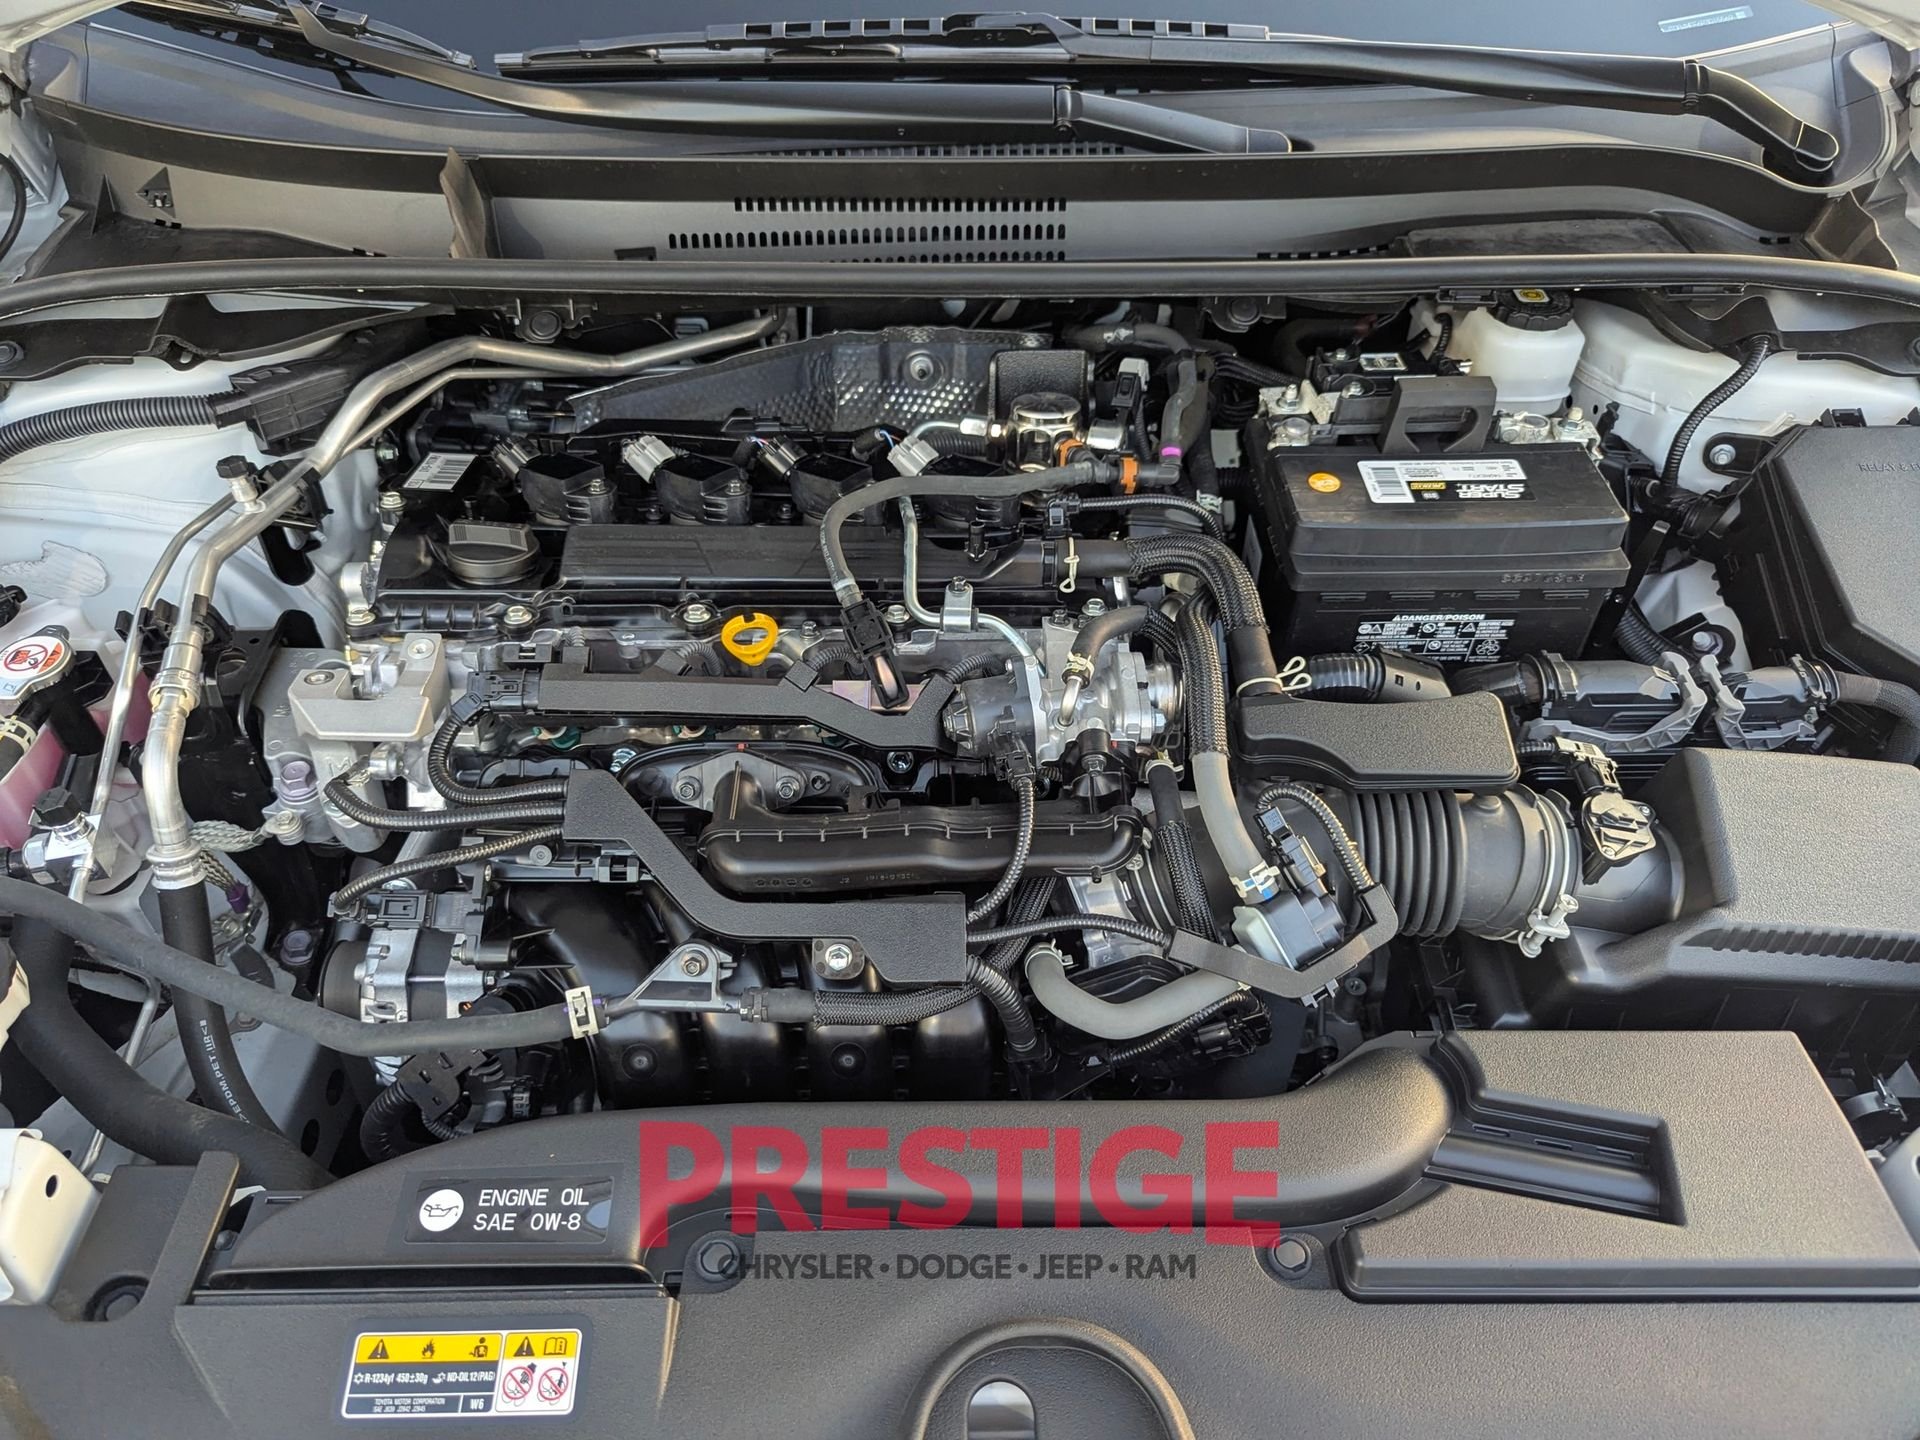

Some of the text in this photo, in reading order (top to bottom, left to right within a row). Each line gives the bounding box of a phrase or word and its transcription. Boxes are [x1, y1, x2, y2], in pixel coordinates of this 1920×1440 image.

[1857, 462, 1896, 472] RELAY
[1456, 483, 1525, 493] START
[1458, 491, 1521, 499] SUPER
[478, 1187, 590, 1207] ENGINE OIL
[473, 1212, 582, 1231] SAE 0W-8
[364, 1372, 395, 1385] R-1234yf
[470, 1398, 485, 1410] W6
